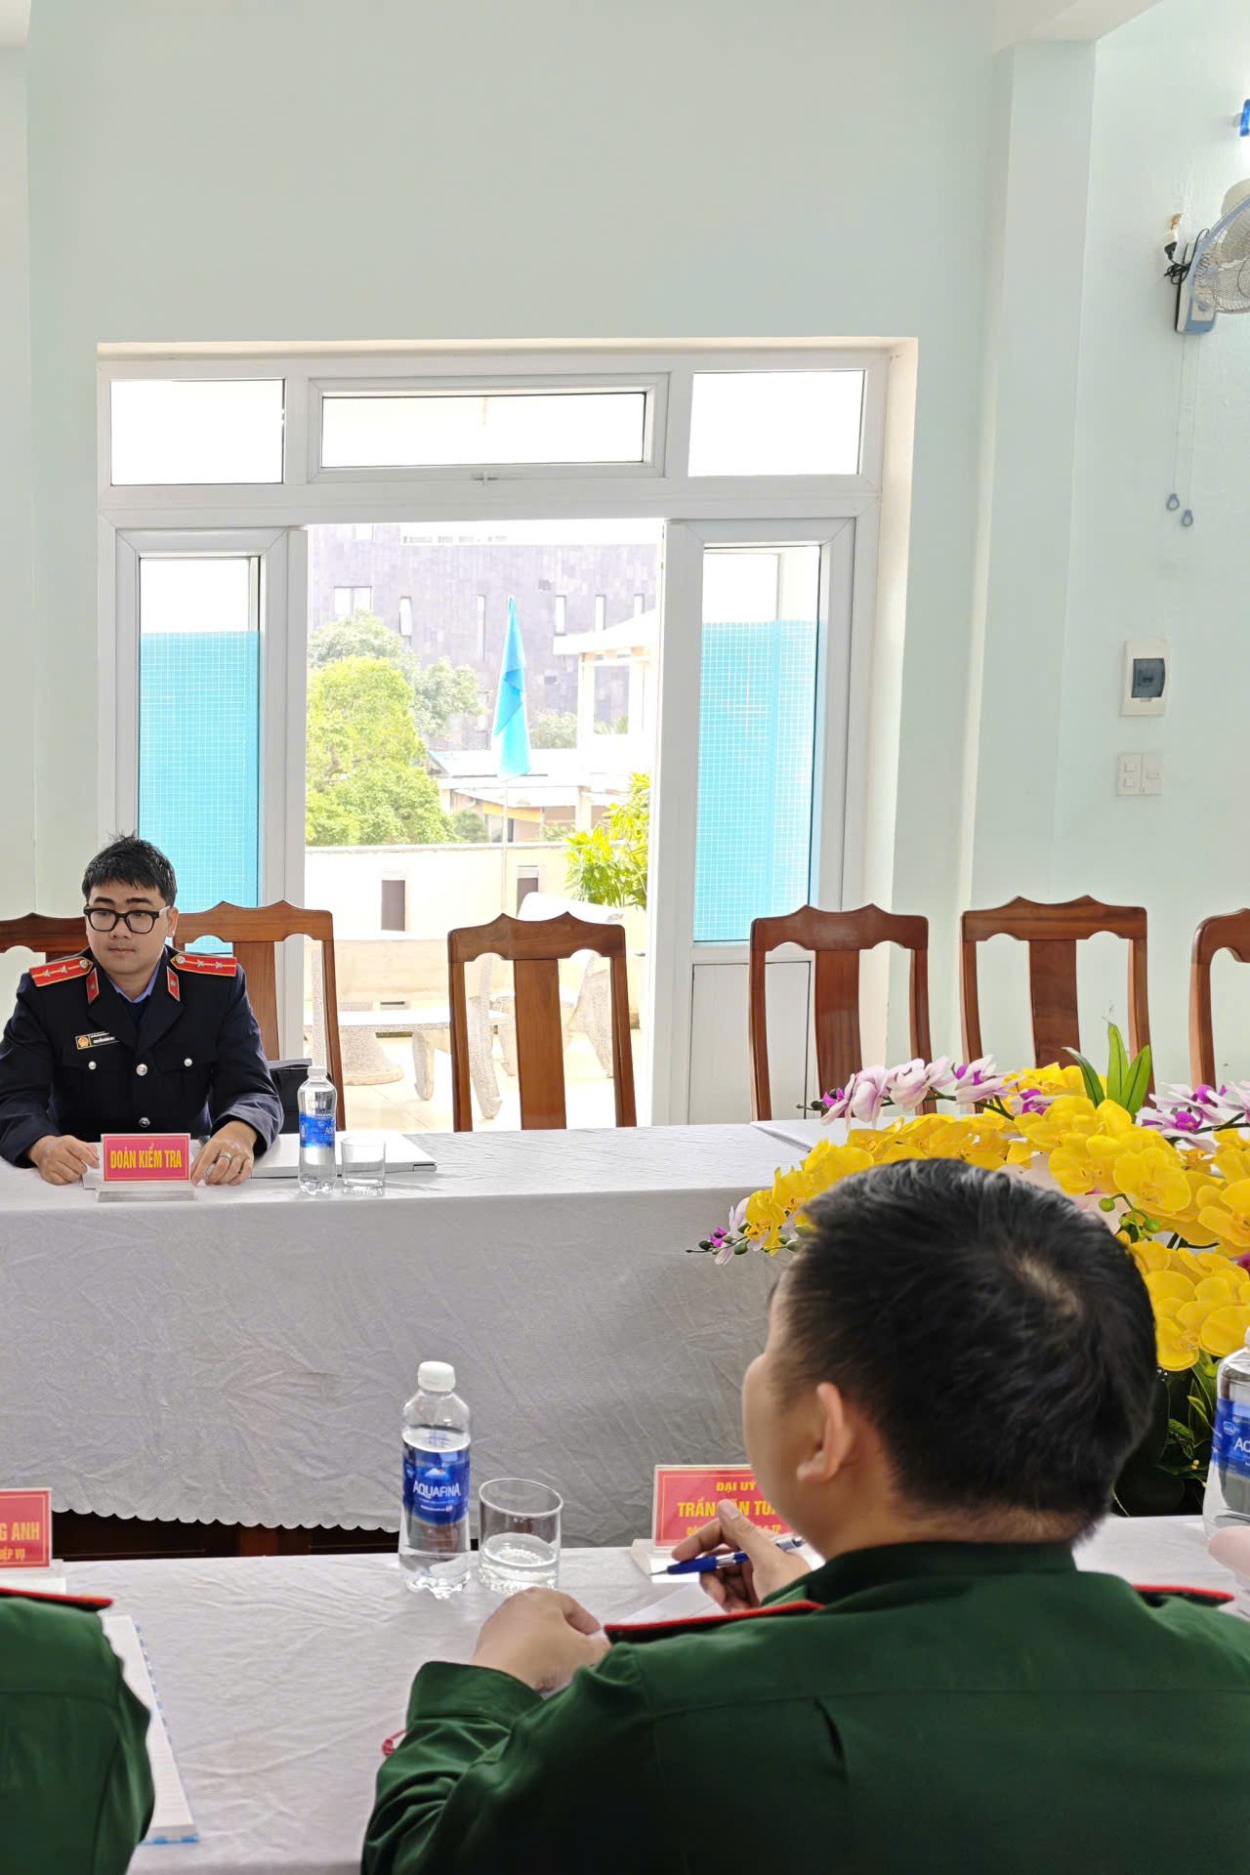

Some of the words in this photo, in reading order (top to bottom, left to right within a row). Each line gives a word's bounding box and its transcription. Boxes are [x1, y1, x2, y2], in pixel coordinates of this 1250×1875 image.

[110, 1145, 136, 1169] ĐOÀN
[138, 1142, 162, 1168] KIỂM
[164, 1149, 182, 1168] TRA
[413, 1480, 461, 1499] AQUAFINA
[716, 1481, 737, 1493] ĐẠI
[11, 1521, 40, 1540] ANH
[14, 1548, 25, 1562] VỤ
